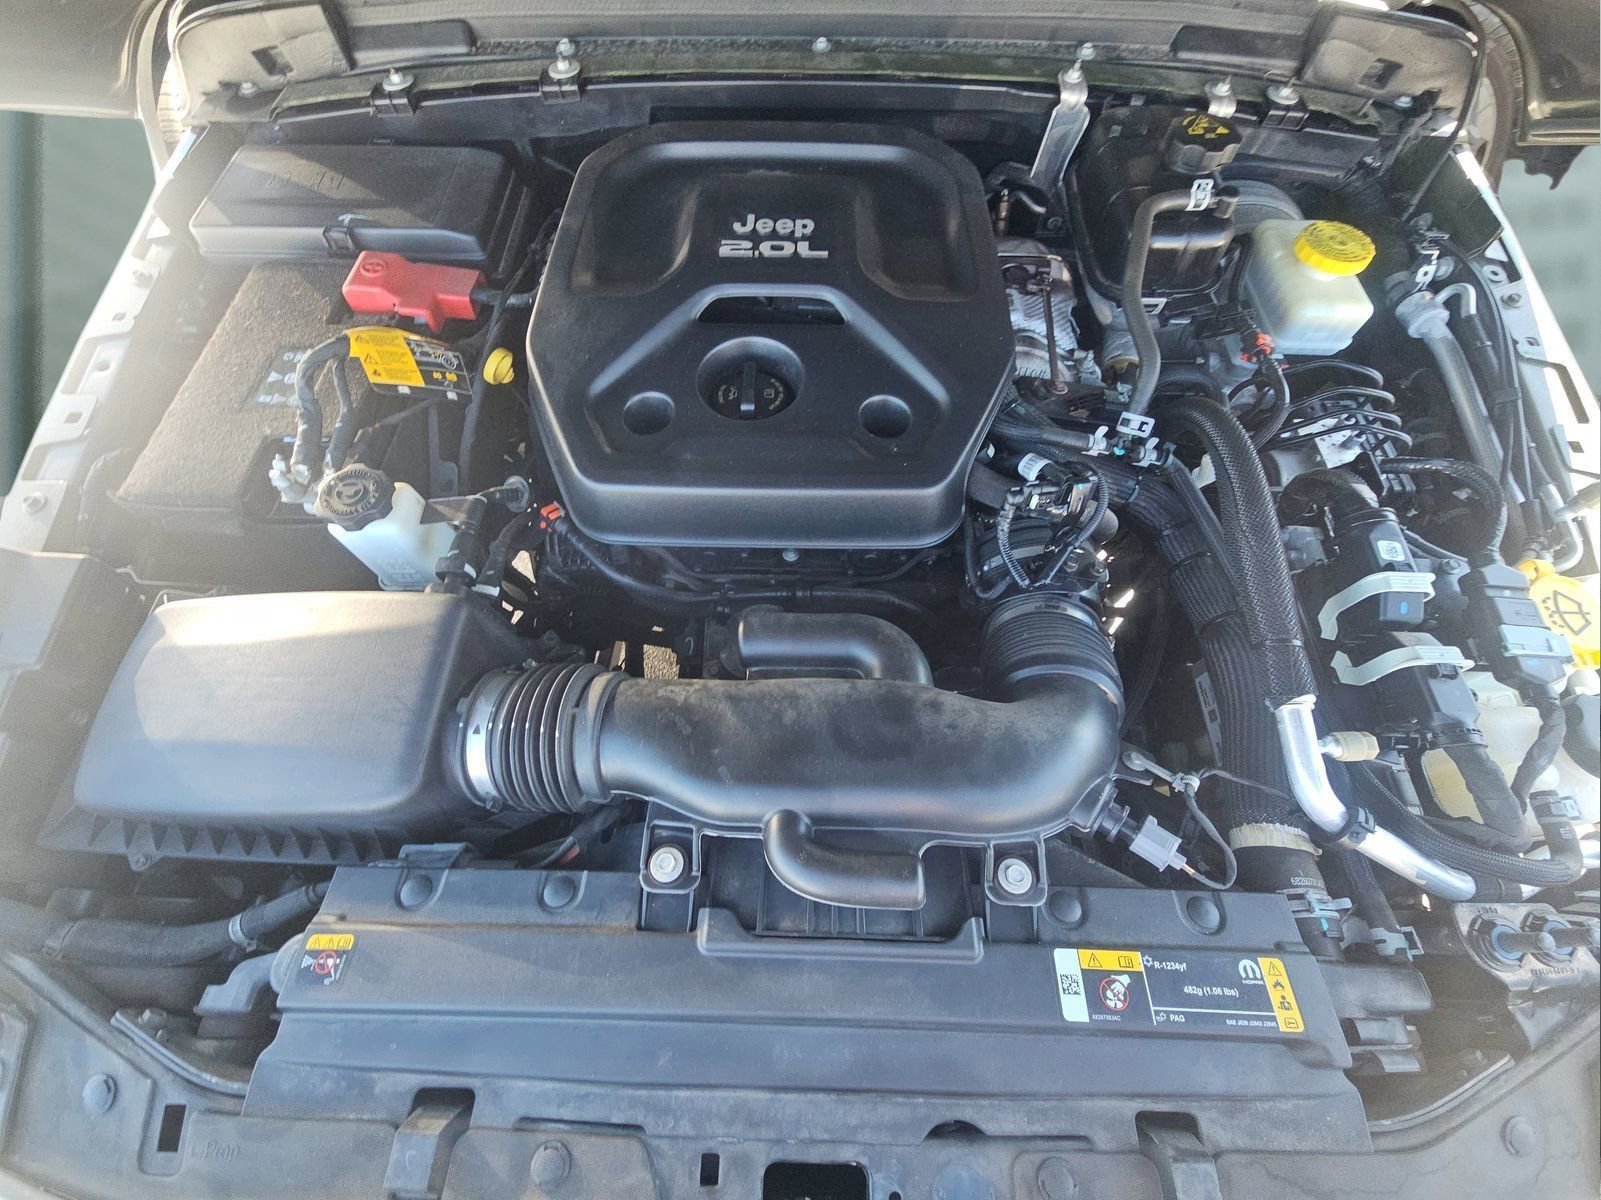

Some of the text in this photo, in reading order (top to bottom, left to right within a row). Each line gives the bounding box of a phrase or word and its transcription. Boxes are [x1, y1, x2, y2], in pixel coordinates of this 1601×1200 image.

[732, 213, 815, 238] Jeep
[718, 239, 829, 258] 2.0L
[1183, 985, 1203, 997] 482g
[1223, 987, 1239, 998] lbs)
[1169, 1014, 1186, 1023] PAG
